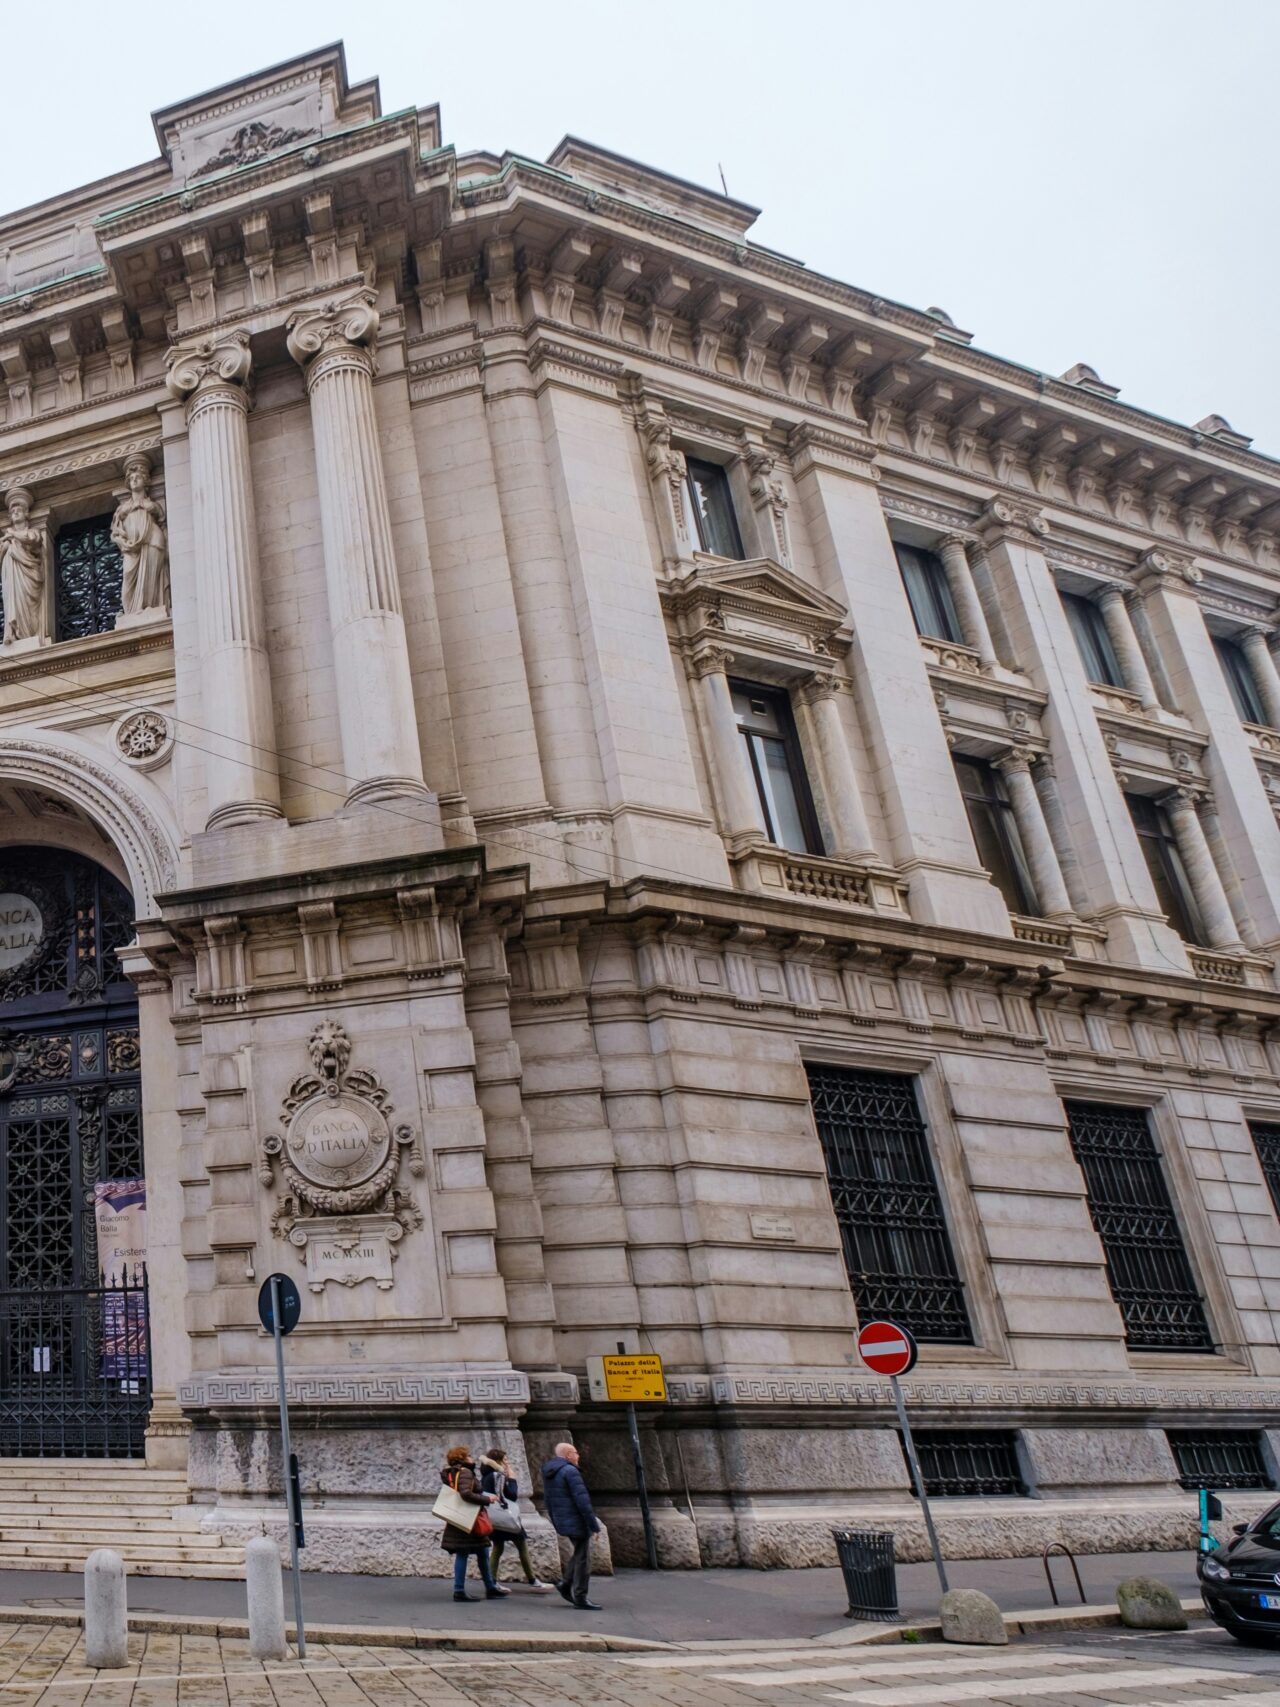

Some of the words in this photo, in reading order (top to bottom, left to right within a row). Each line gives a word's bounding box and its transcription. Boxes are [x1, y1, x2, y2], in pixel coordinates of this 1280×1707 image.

[312, 1121, 359, 1136] BANCA
[307, 1138, 366, 1154] DITALIA
[100, 1214, 129, 1223] Giacomo
[100, 1224, 118, 1233] Balla
[114, 1247, 147, 1257] Esistere
[322, 1248, 374, 1260] MCMXIII
